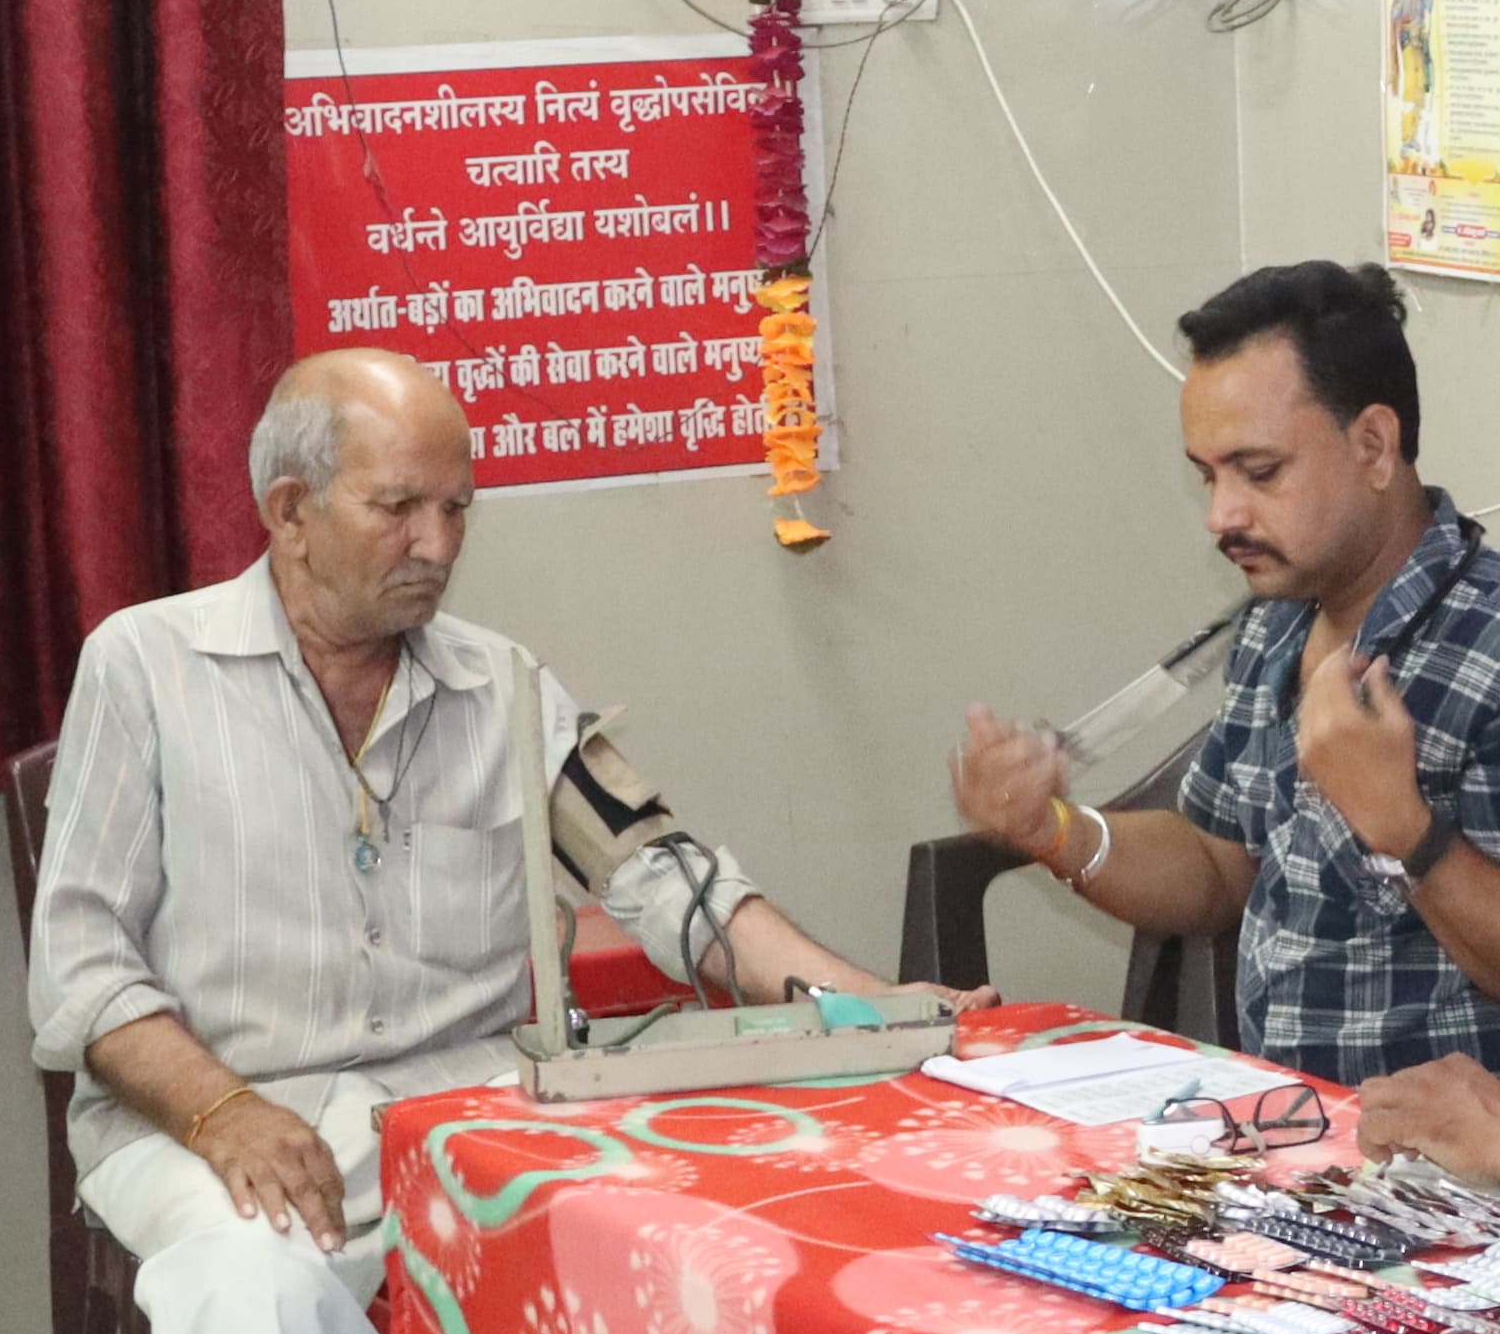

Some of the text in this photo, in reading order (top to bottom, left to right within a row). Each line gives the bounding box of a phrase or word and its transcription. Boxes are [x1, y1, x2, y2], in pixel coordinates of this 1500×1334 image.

[284, 83, 525, 137] अभिवादनशीलस्य
[534, 79, 600, 125] नित्यं
[465, 141, 630, 187] चत्वारि तस्य
[454, 288, 484, 322] का
[492, 276, 597, 322] अभिवादन
[604, 267, 654, 311] करने
[661, 264, 706, 308] वाले
[456, 346, 505, 402] वृद्धों
[508, 345, 541, 386] की
[545, 341, 591, 384] सेवा
[598, 334, 645, 378] करने
[652, 331, 698, 376] वाले
[493, 412, 537, 457] और
[541, 418, 582, 452] बल
[586, 405, 608, 448] में
